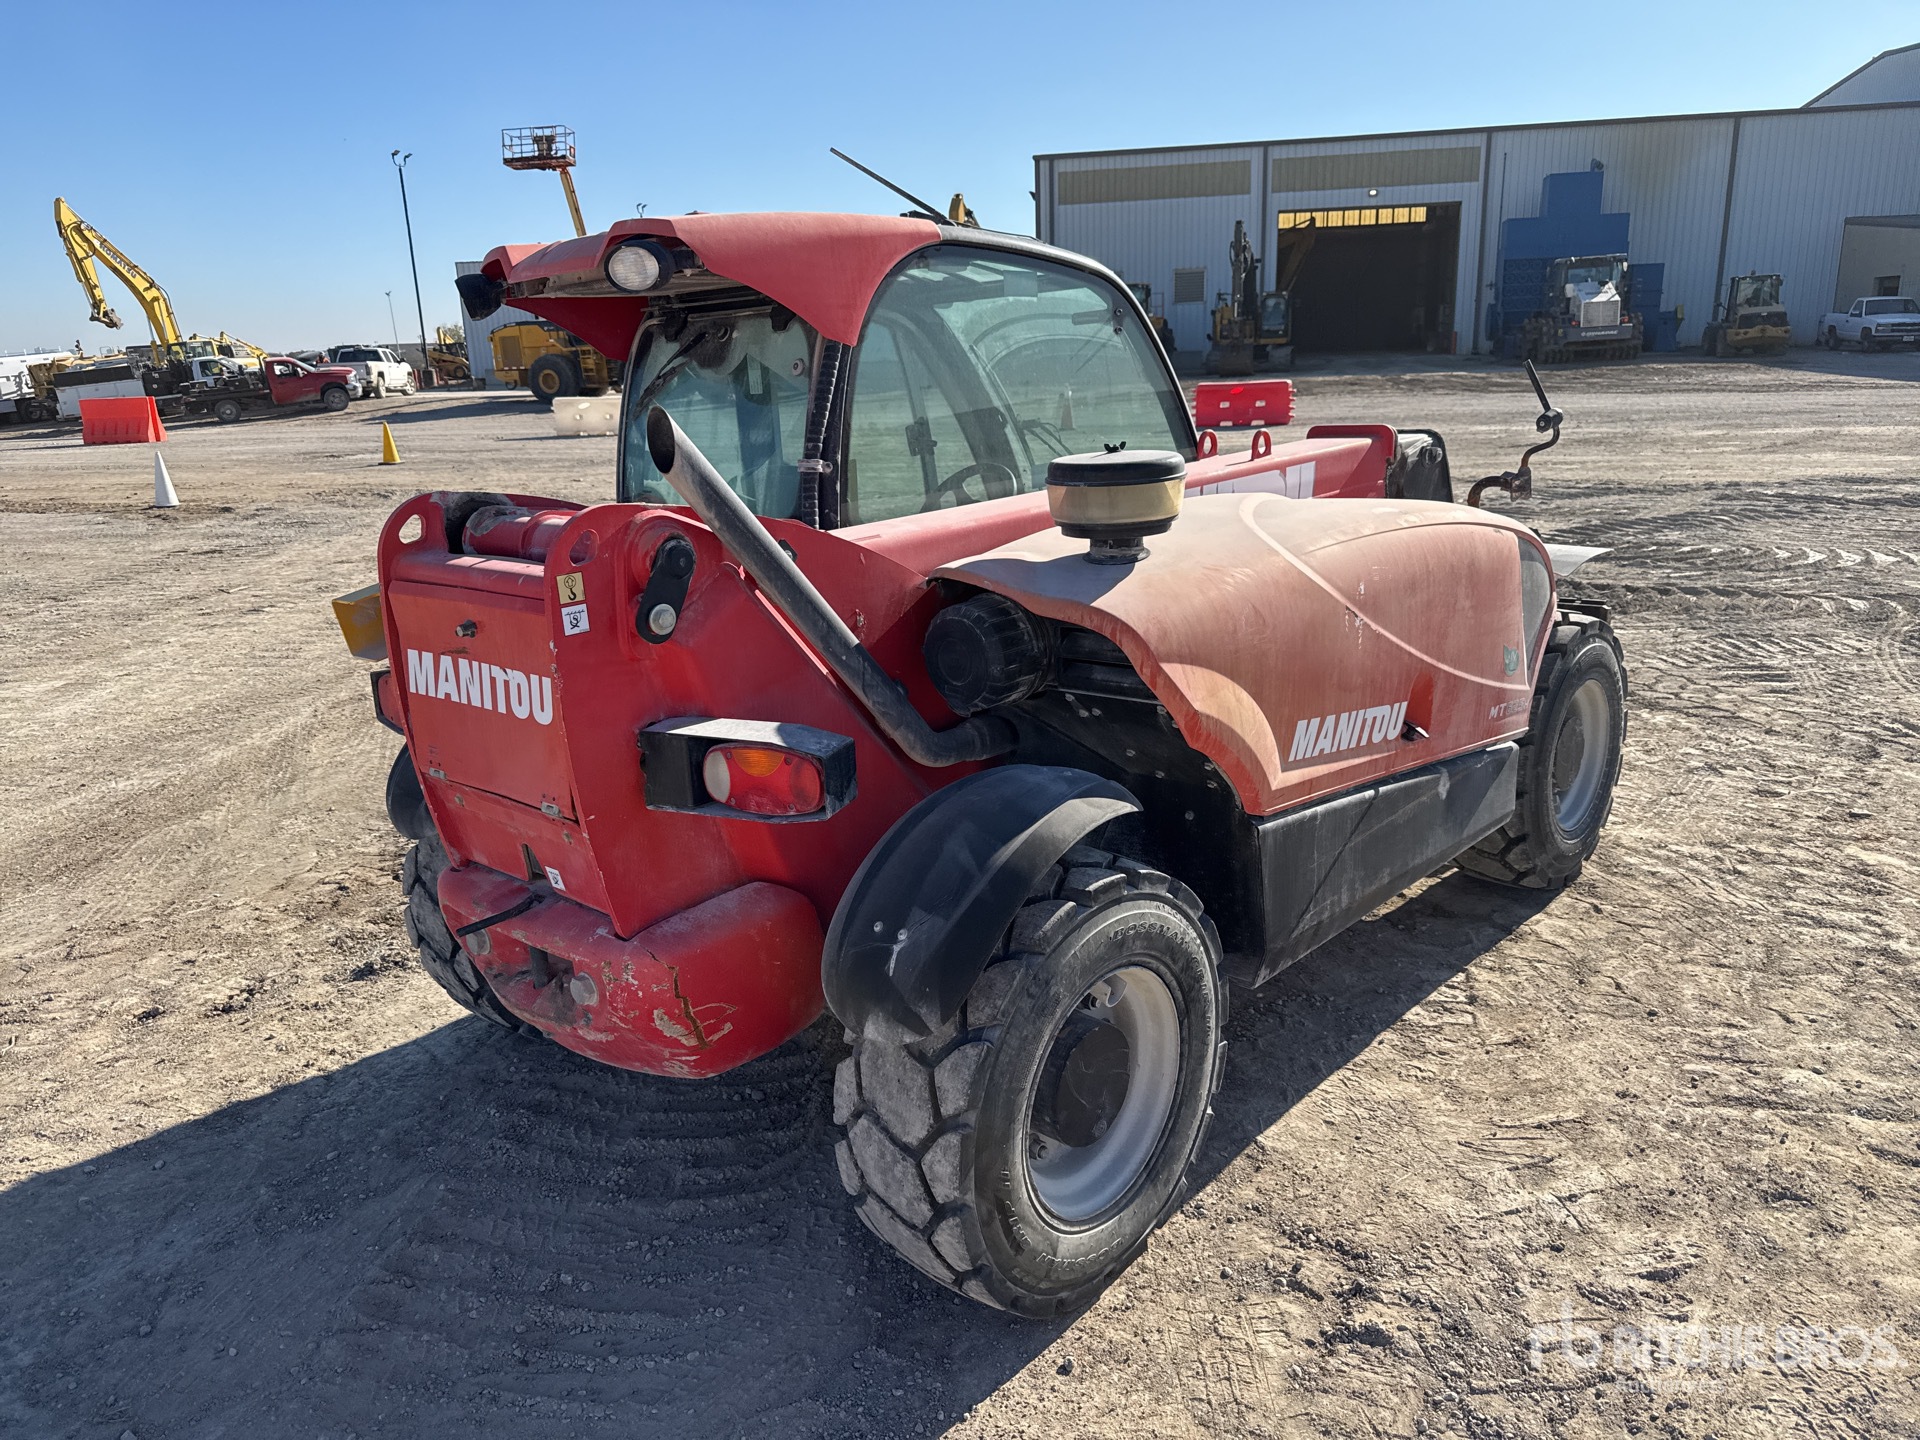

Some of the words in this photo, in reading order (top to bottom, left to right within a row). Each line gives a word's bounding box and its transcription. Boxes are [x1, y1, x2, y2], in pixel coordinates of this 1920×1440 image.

[99, 241, 137, 279] KOMATSU
[407, 648, 553, 726] MANITOU
[1288, 701, 1408, 762] MANITOU
